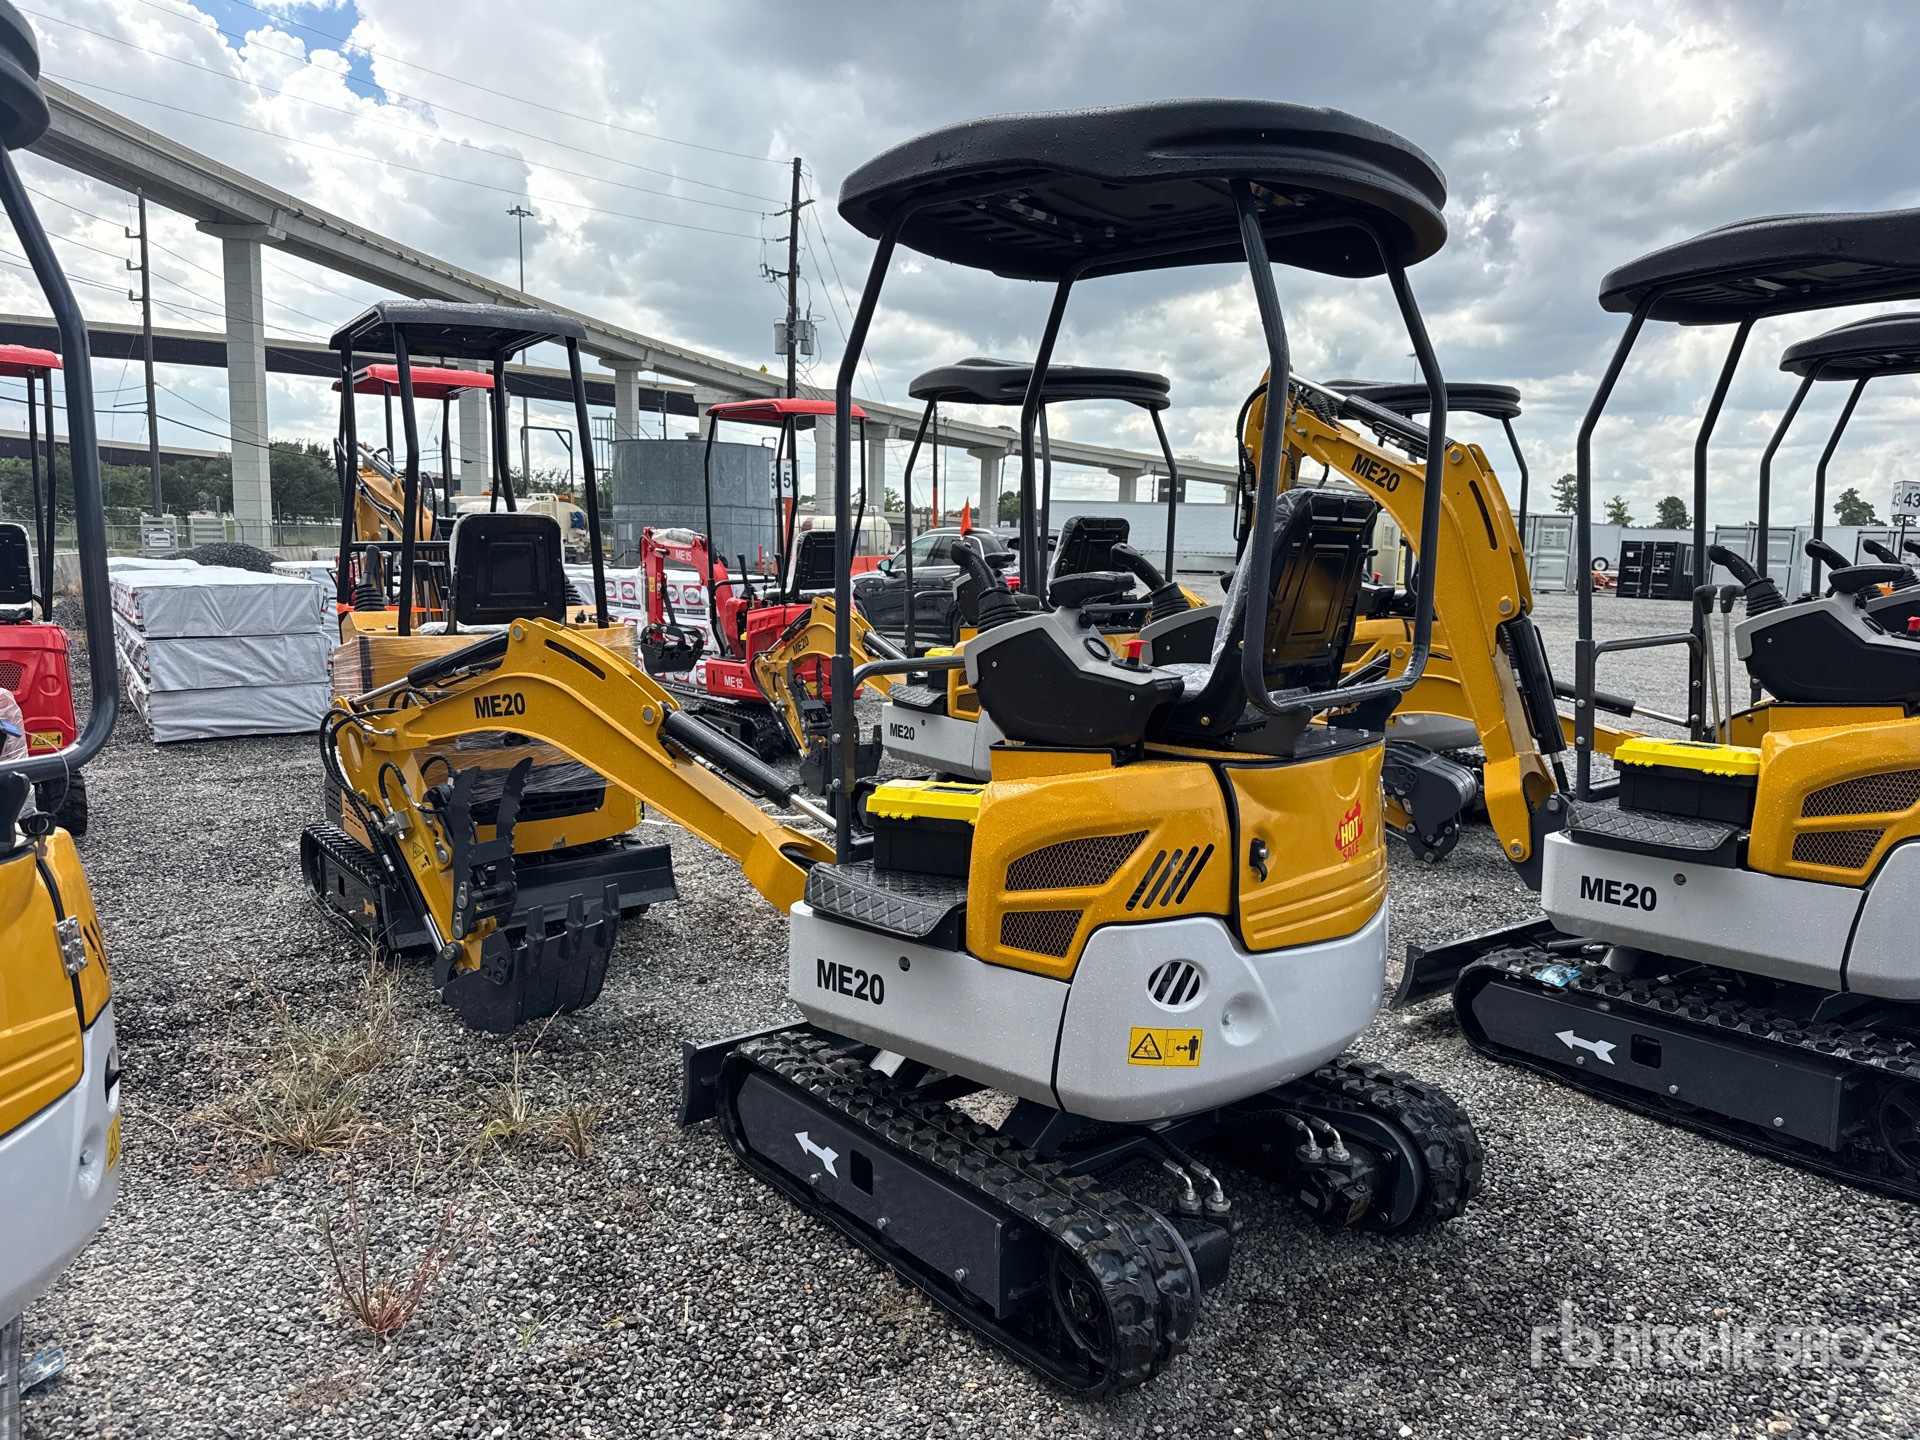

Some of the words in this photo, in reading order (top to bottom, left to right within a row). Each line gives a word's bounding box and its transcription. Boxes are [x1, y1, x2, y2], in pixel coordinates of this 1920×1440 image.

[1351, 452, 1400, 493] ME20
[1903, 492, 1920, 508] 43
[675, 549, 692, 562] ME15
[792, 635, 810, 656] ME20
[724, 675, 744, 689] ME15
[473, 692, 526, 719] ME20
[889, 722, 915, 741] ME20
[1340, 815, 1359, 848] HOT
[1342, 840, 1360, 863] SALE
[1580, 875, 1657, 912] ME20
[816, 957, 885, 1006] ME20
